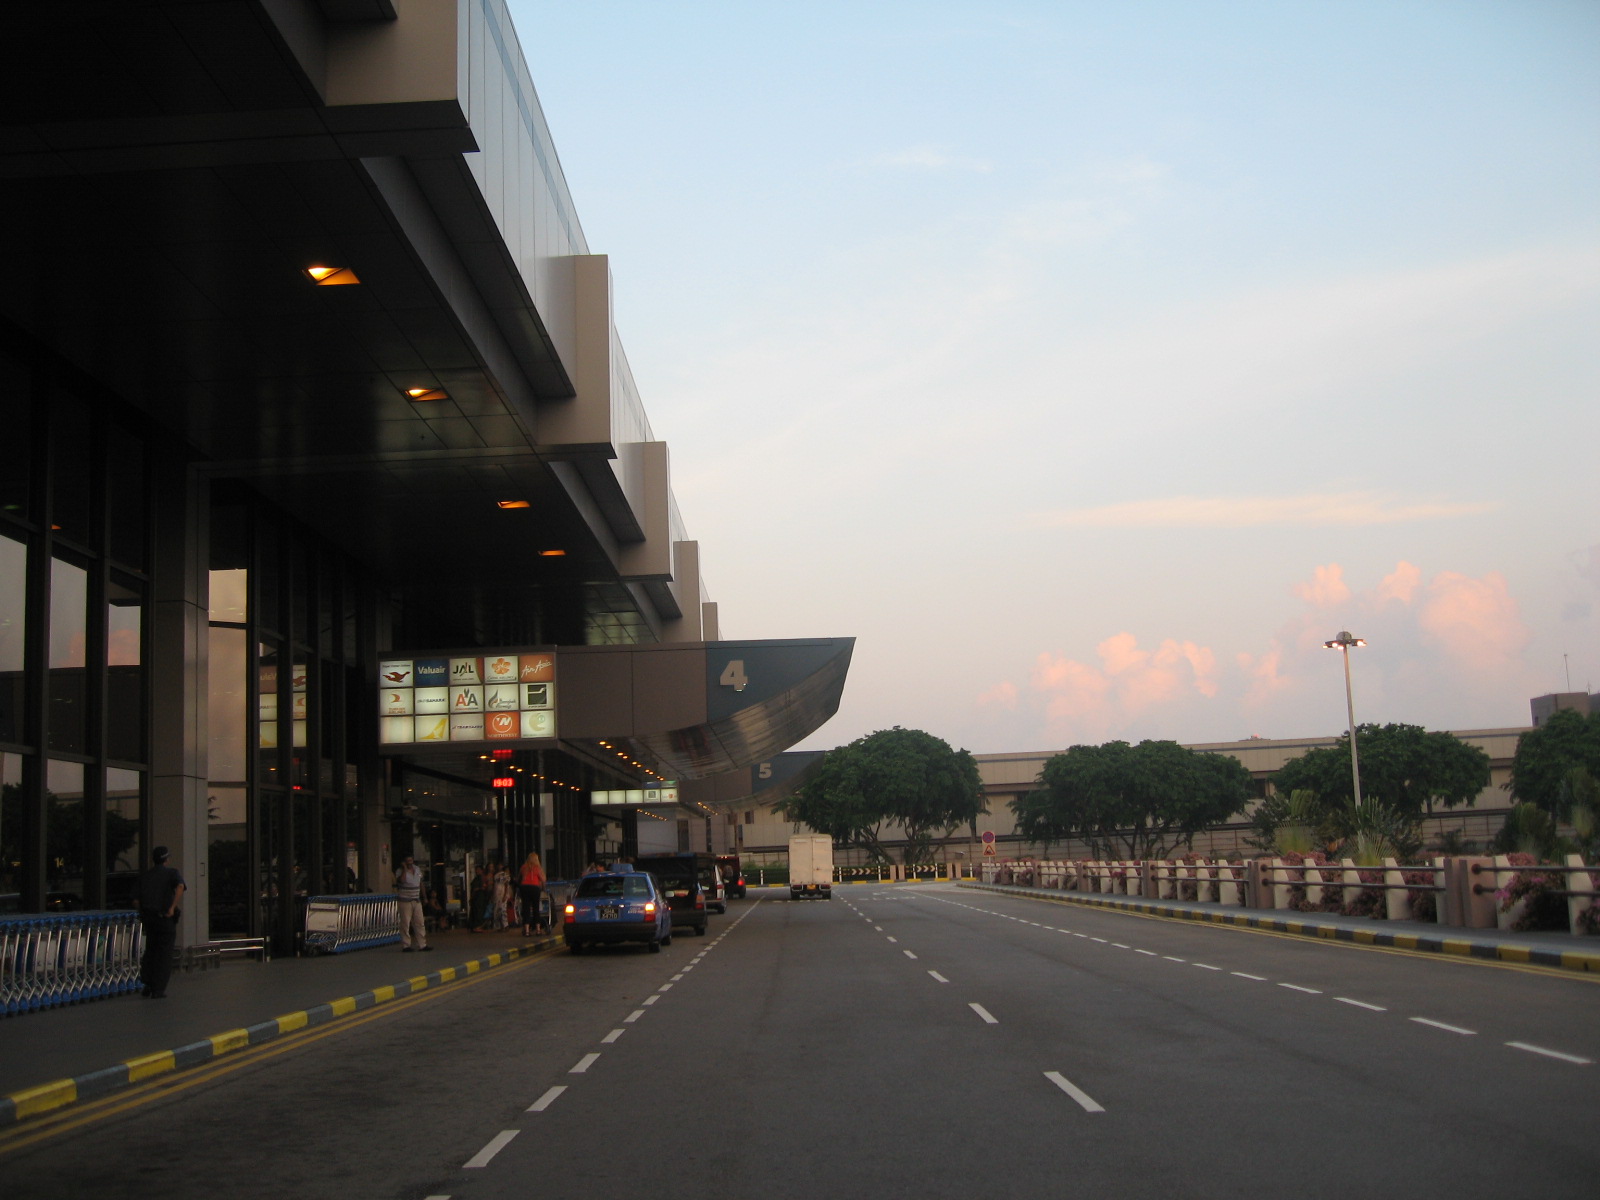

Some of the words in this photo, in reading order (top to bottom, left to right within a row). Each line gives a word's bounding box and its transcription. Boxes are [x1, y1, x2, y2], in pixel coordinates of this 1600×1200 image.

[417, 665, 446, 675] Valuair
[452, 662, 475, 675] JAL
[719, 659, 749, 692] 4
[455, 692, 479, 707] AA
[758, 763, 772, 779] 5
